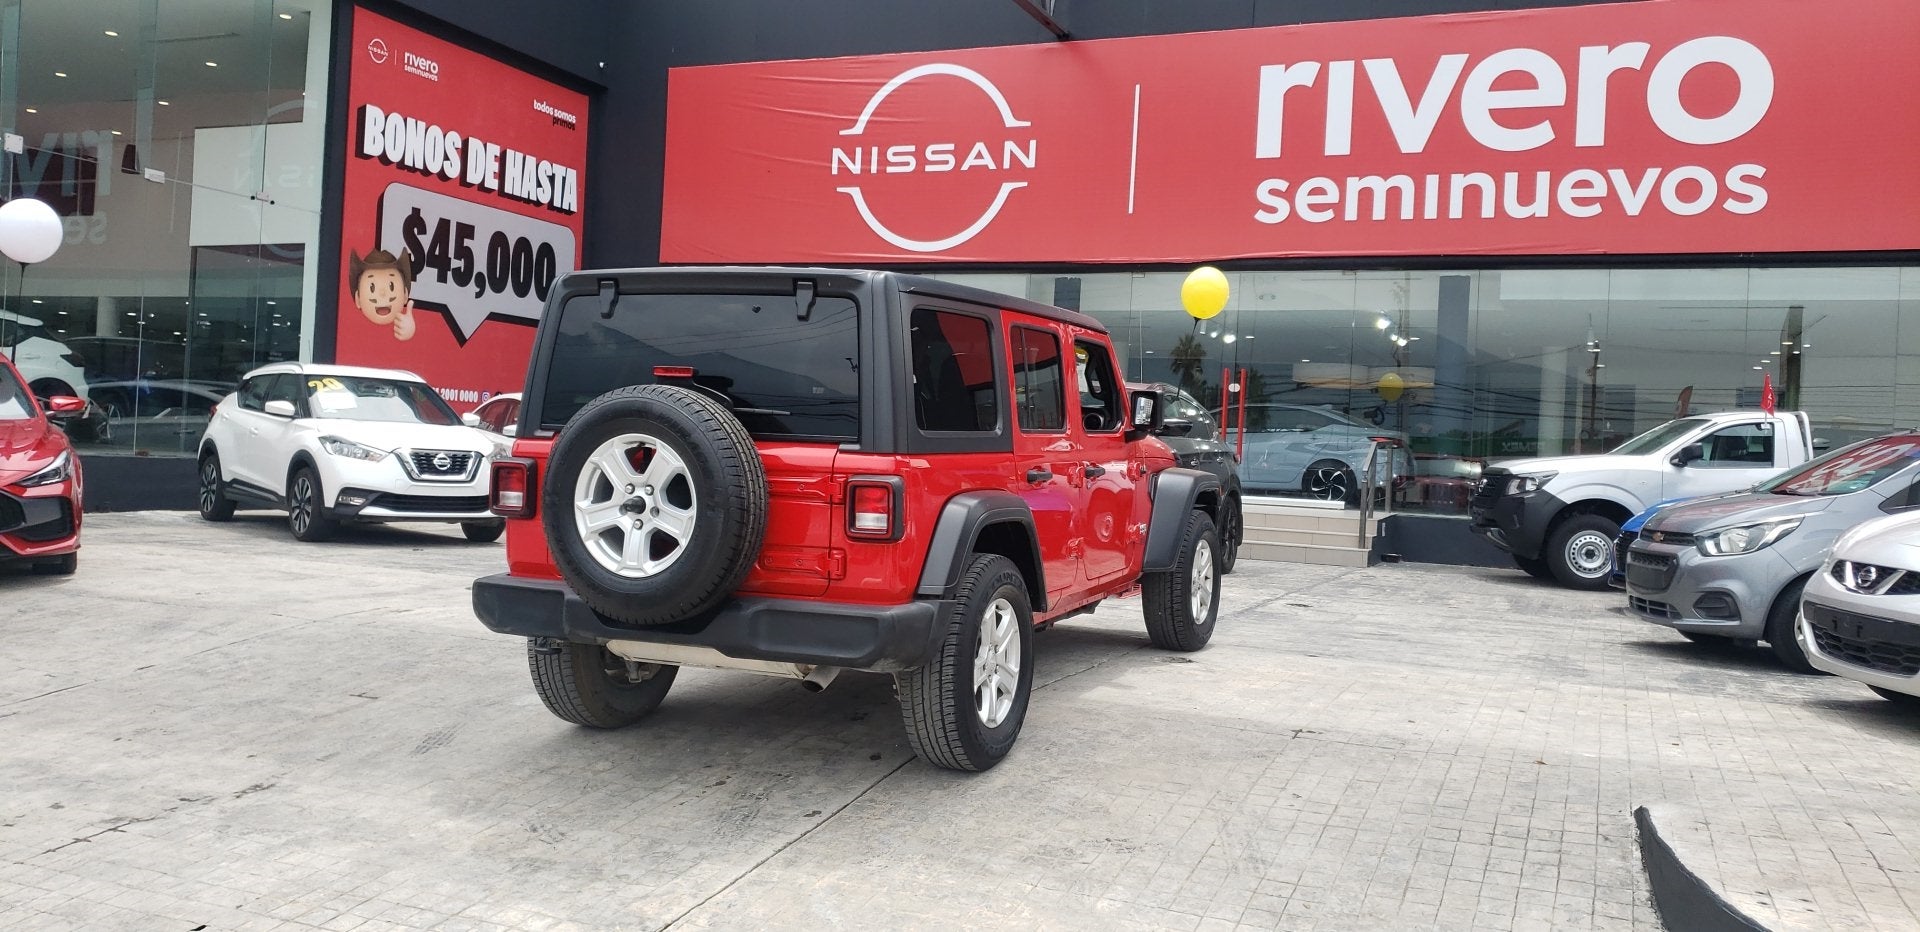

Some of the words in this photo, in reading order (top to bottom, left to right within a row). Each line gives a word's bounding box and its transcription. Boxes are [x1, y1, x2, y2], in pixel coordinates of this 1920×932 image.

[368, 45, 389, 57] NISSAN
[404, 51, 439, 75] rivero
[404, 64, 438, 82] seminuevos
[1255, 35, 1775, 159] rivero
[533, 99, 554, 116] todos
[554, 108, 577, 124] somos
[552, 117, 576, 131] primos
[362, 104, 462, 180] BONOS
[465, 137, 501, 191] DE
[504, 149, 578, 213] HASTA
[831, 139, 1037, 175] NISSAN
[1253, 163, 1769, 224] seminuevos
[402, 206, 557, 303] $45,000
[460, 389, 479, 403] 0000
